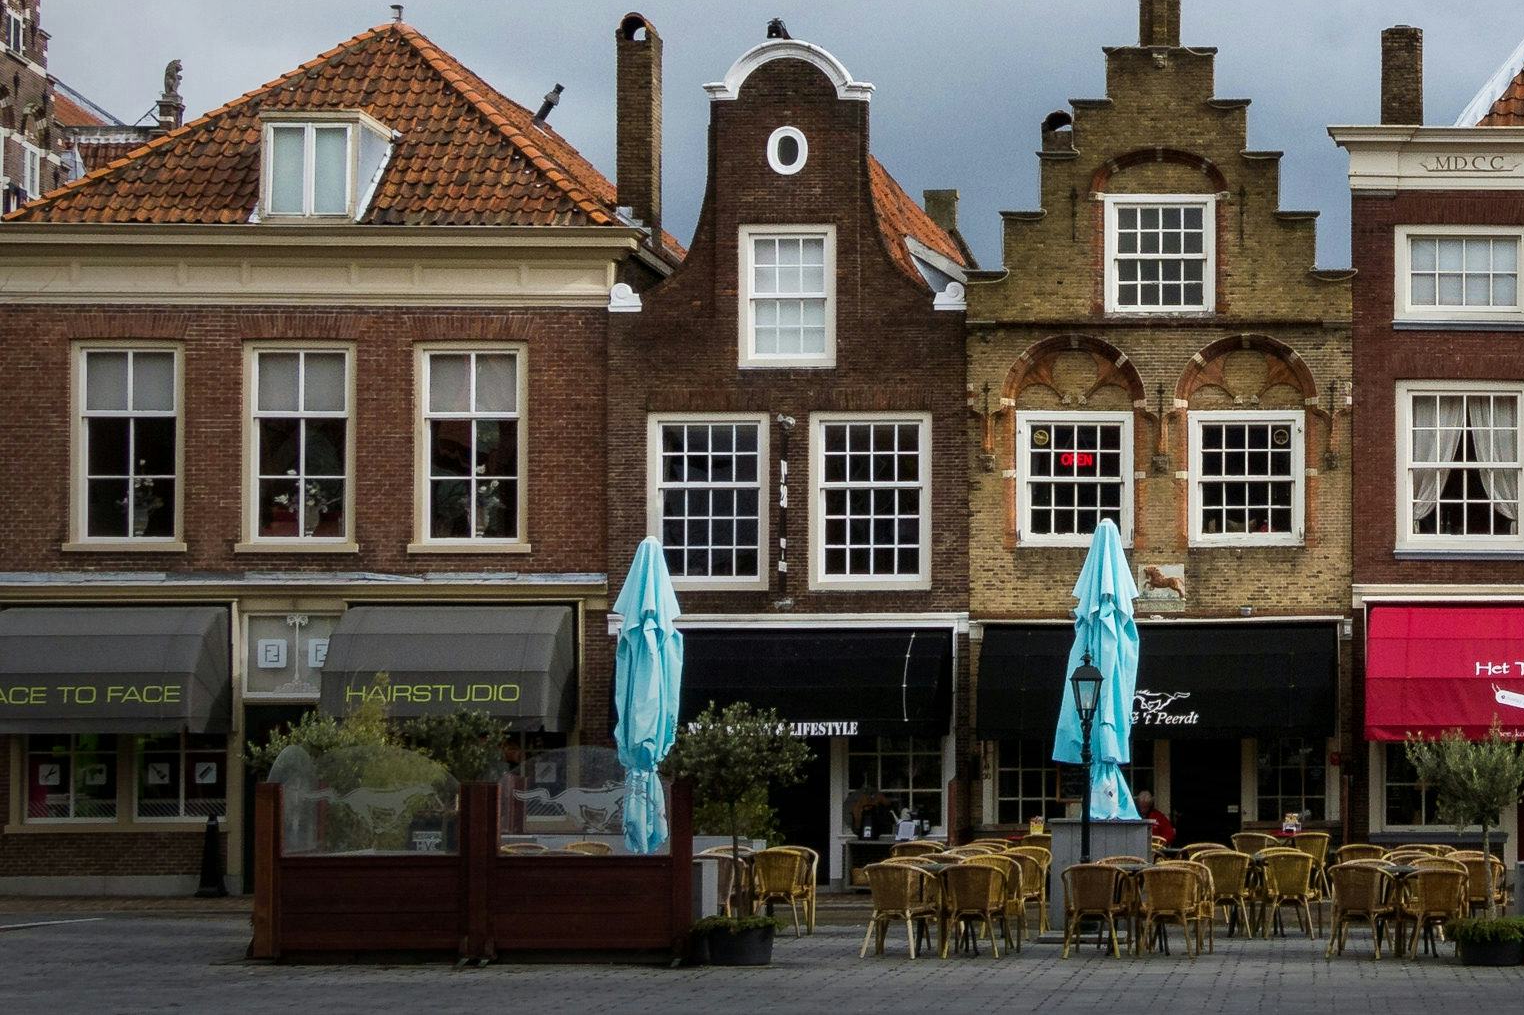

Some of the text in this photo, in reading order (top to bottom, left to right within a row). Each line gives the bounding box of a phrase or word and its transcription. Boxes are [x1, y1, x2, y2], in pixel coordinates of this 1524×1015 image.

[1435, 155, 1505, 170] MDCC
[1060, 453, 1093, 466] OPEN
[1475, 661, 1510, 676] Het
[57, 685, 97, 704] TO
[106, 685, 182, 703] FACE
[345, 684, 520, 703] HAIRSTUDIO
[1142, 712, 1152, 725] 't
[1154, 711, 1199, 725] Peerdt
[790, 721, 858, 736] LIFESTYLE
